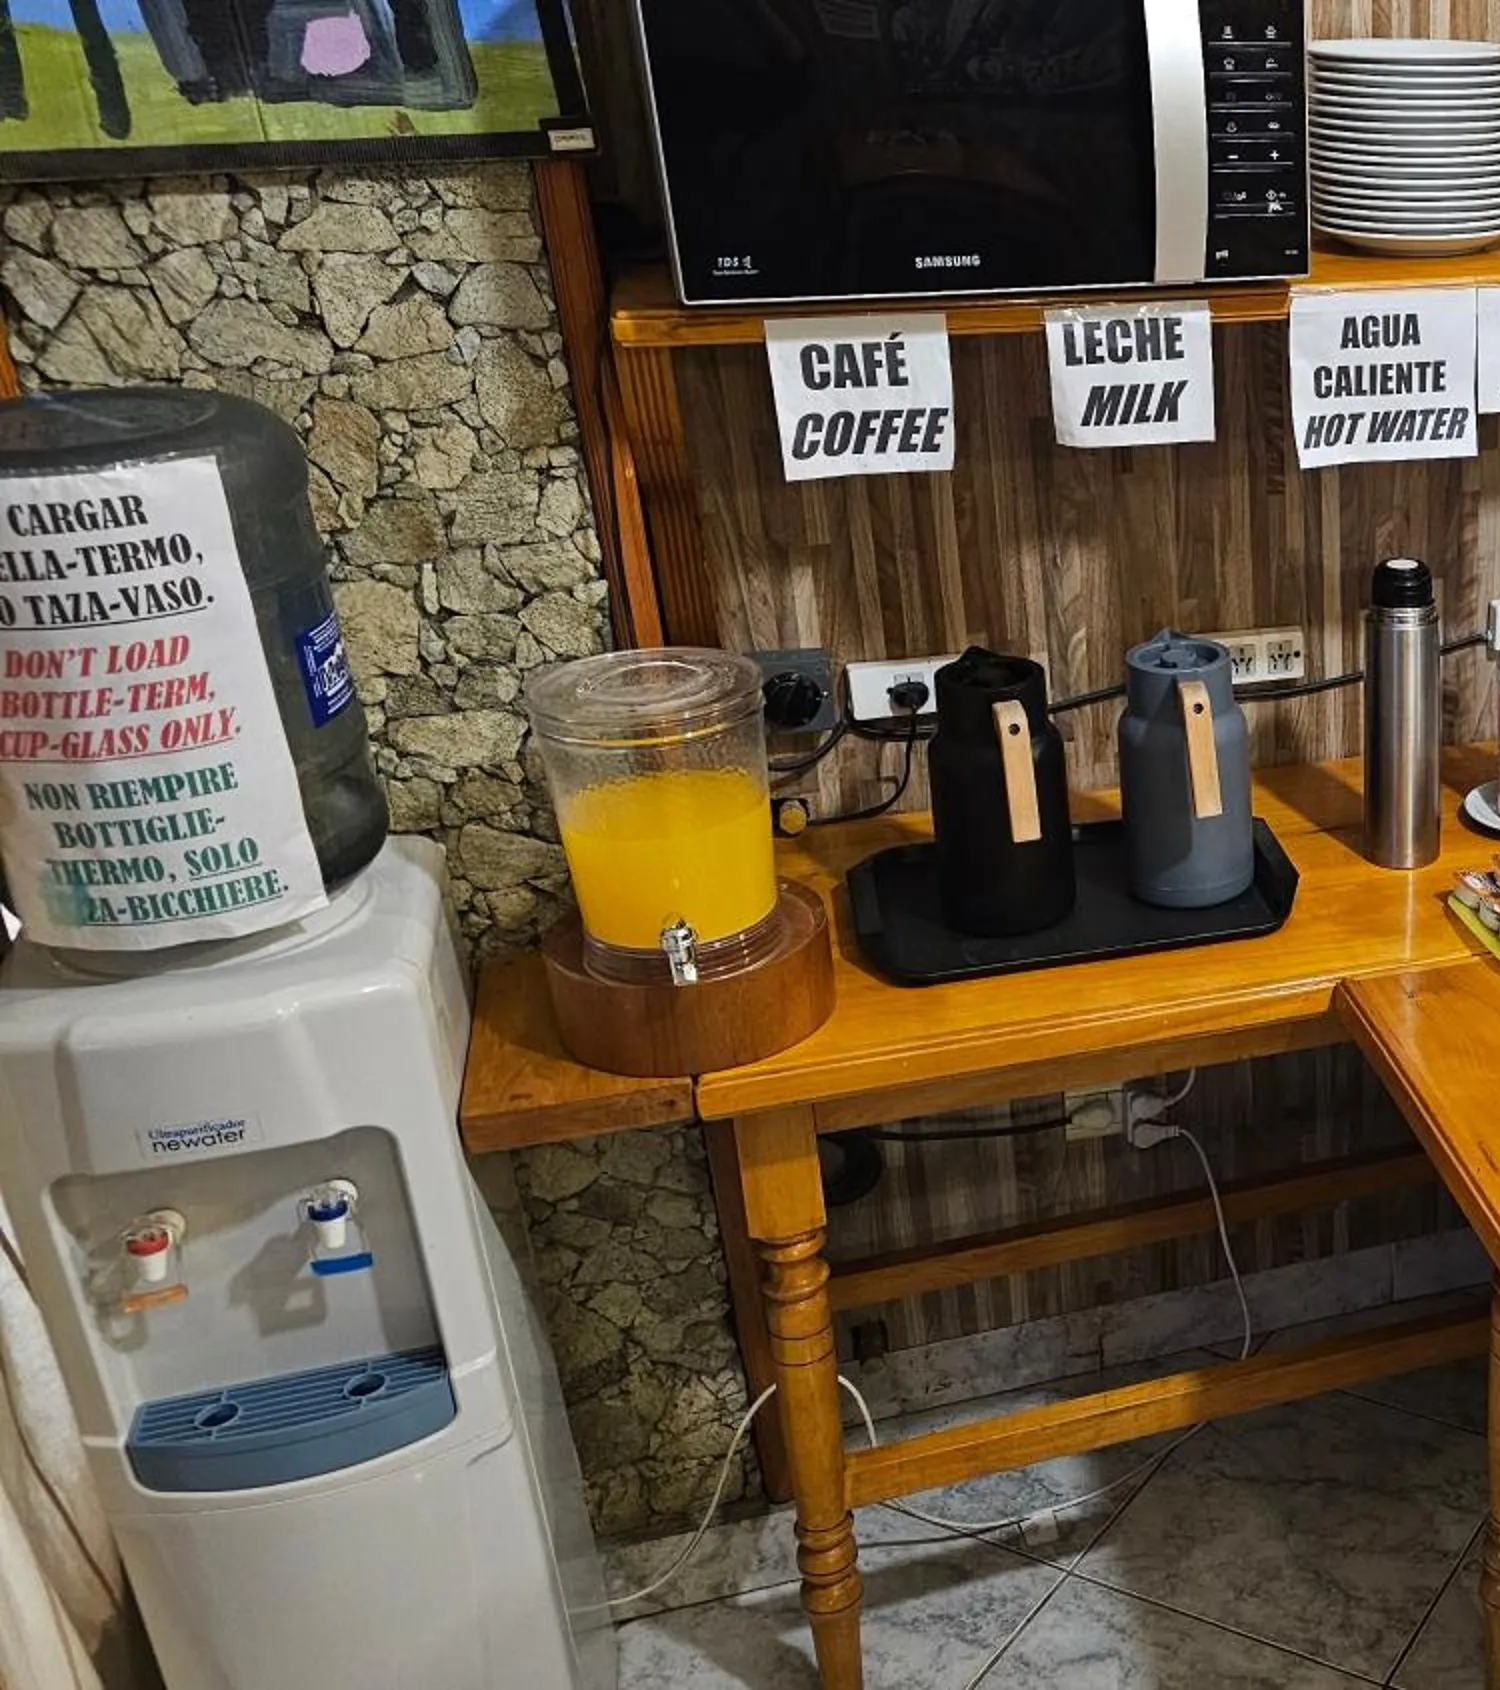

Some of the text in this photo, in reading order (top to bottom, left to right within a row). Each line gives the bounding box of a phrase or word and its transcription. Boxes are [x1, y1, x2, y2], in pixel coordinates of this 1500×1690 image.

[915, 254, 981, 269] SAMSUNG
[1062, 317, 1185, 367] LECHE
[1340, 313, 1421, 350] AGUA
[799, 331, 909, 391] CAFÉ
[1313, 360, 1447, 399] CALIENTE
[1080, 380, 1189, 427] MILK
[791, 407, 949, 460] COFFEE
[1303, 407, 1469, 450] HOT WATER
[7, 495, 148, 537] CARGAR
[23, 576, 214, 626] TAZA-VASO.
[4, 634, 190, 680] DON'T LOAD
[0, 706, 241, 760] CUP-GLASS ONLY.
[24, 761, 238, 811] NON RIEMPIRE
[52, 807, 225, 849] BOTTIGLIE-
[45, 837, 259, 886] THERMO, SOLO
[152, 1129, 245, 1153] newater
